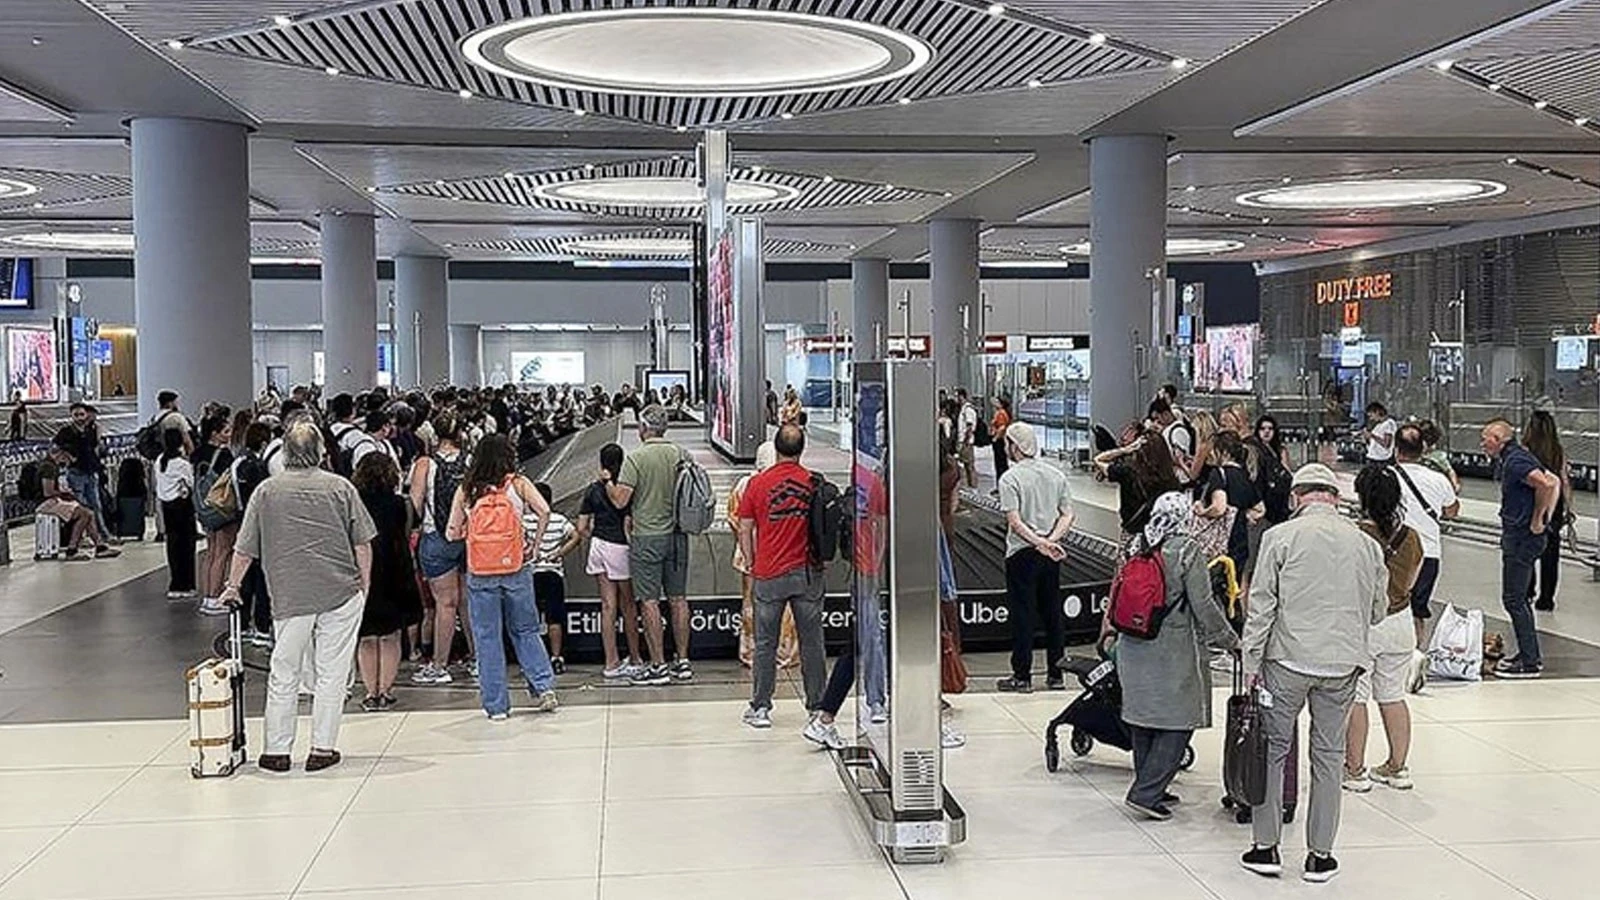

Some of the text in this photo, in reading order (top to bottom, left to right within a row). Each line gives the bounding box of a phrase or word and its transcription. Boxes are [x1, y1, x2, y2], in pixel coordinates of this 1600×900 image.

[1317, 273, 1392, 305] DUTY FREE
[960, 602, 1009, 623] Ube
